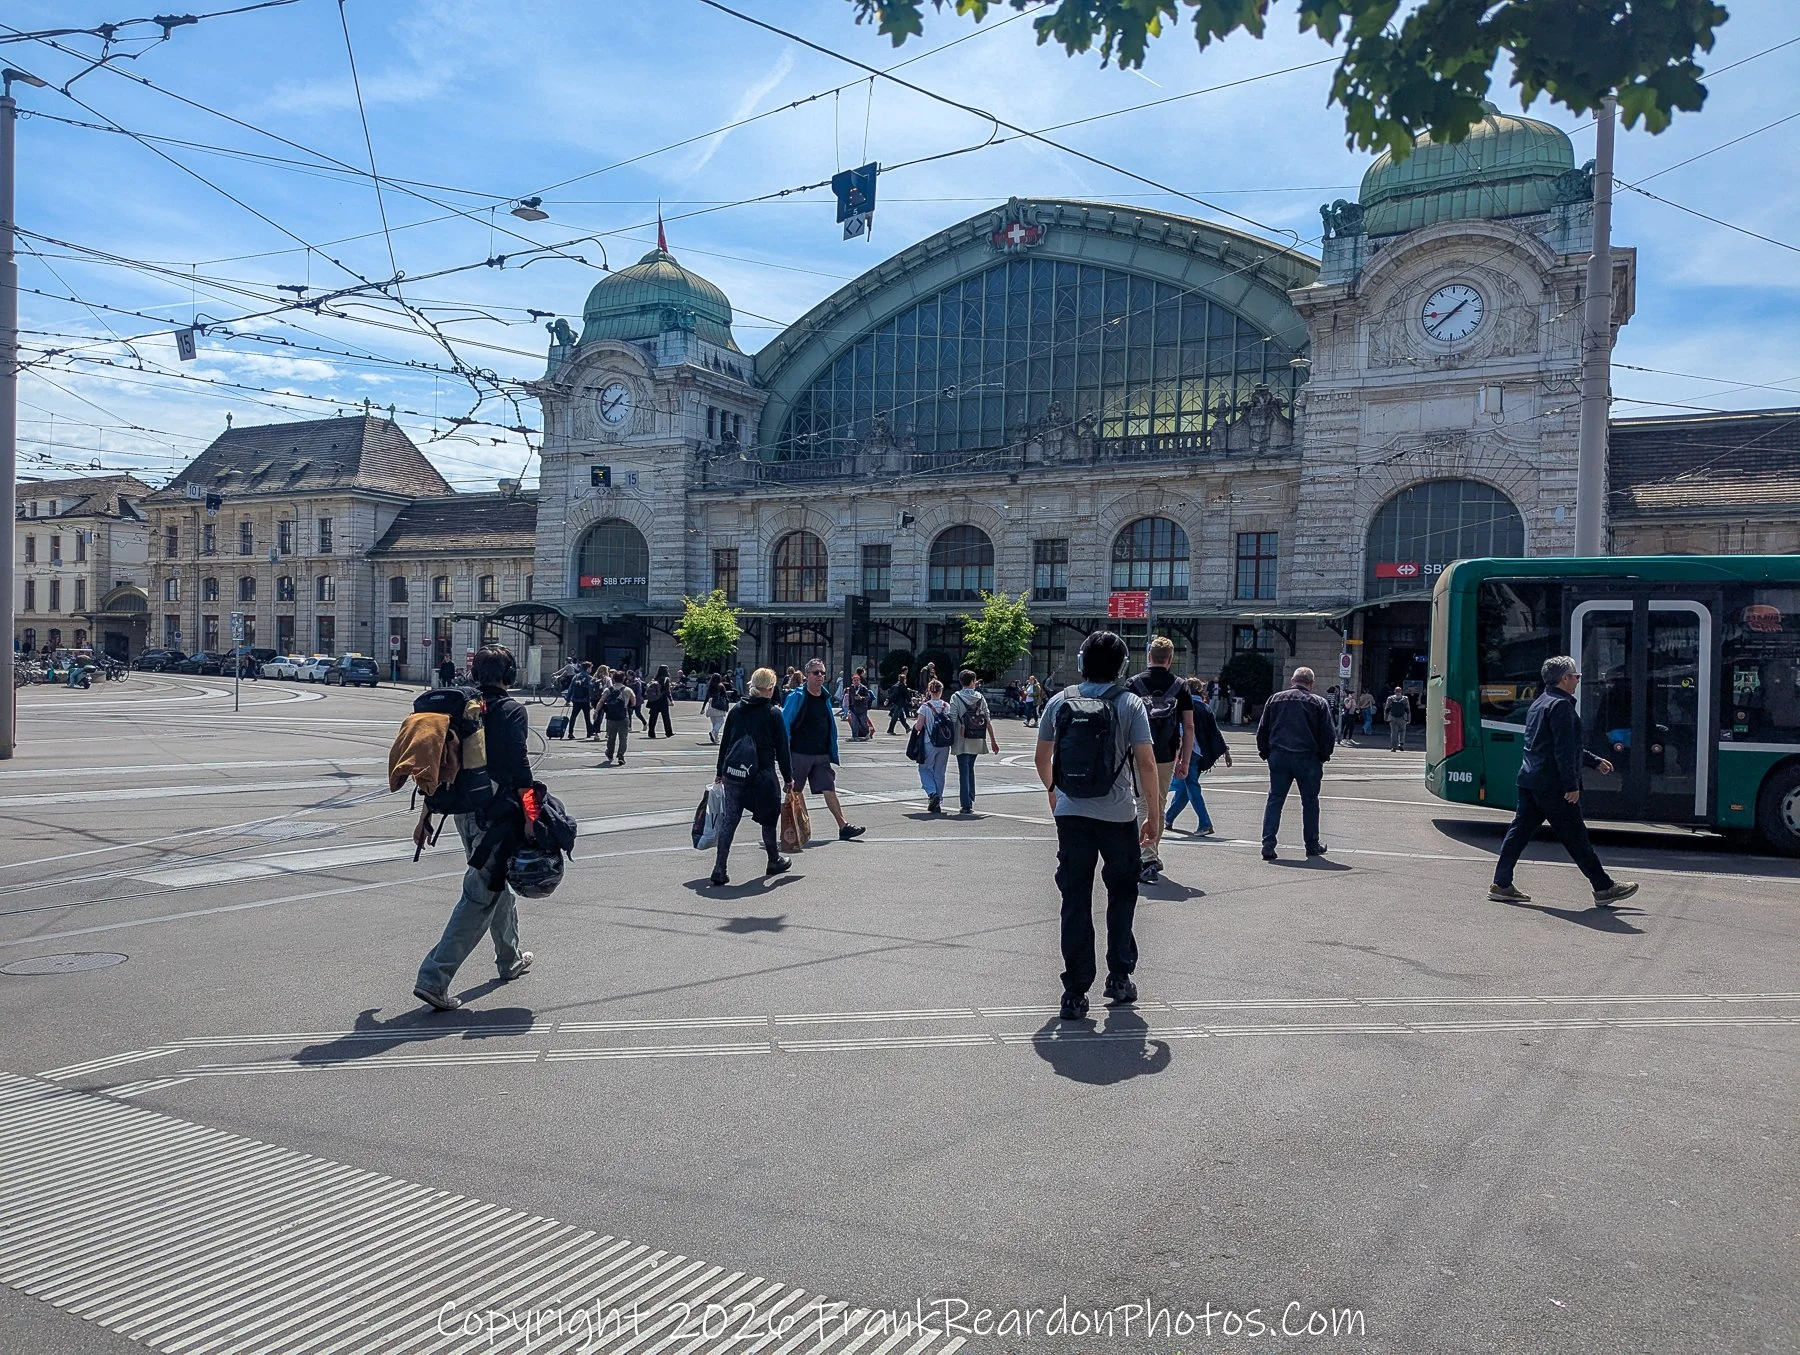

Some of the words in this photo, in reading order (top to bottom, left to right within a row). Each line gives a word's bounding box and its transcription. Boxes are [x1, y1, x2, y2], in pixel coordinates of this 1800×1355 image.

[180, 334, 192, 355] 15
[627, 473, 637, 486] 15
[189, 485, 197, 495] 10
[1423, 563, 1447, 575] SB
[603, 577, 618, 585] SBB
[619, 577, 633, 585] CFF
[633, 576, 647, 585] FFS
[1447, 771, 1473, 783] 7046
